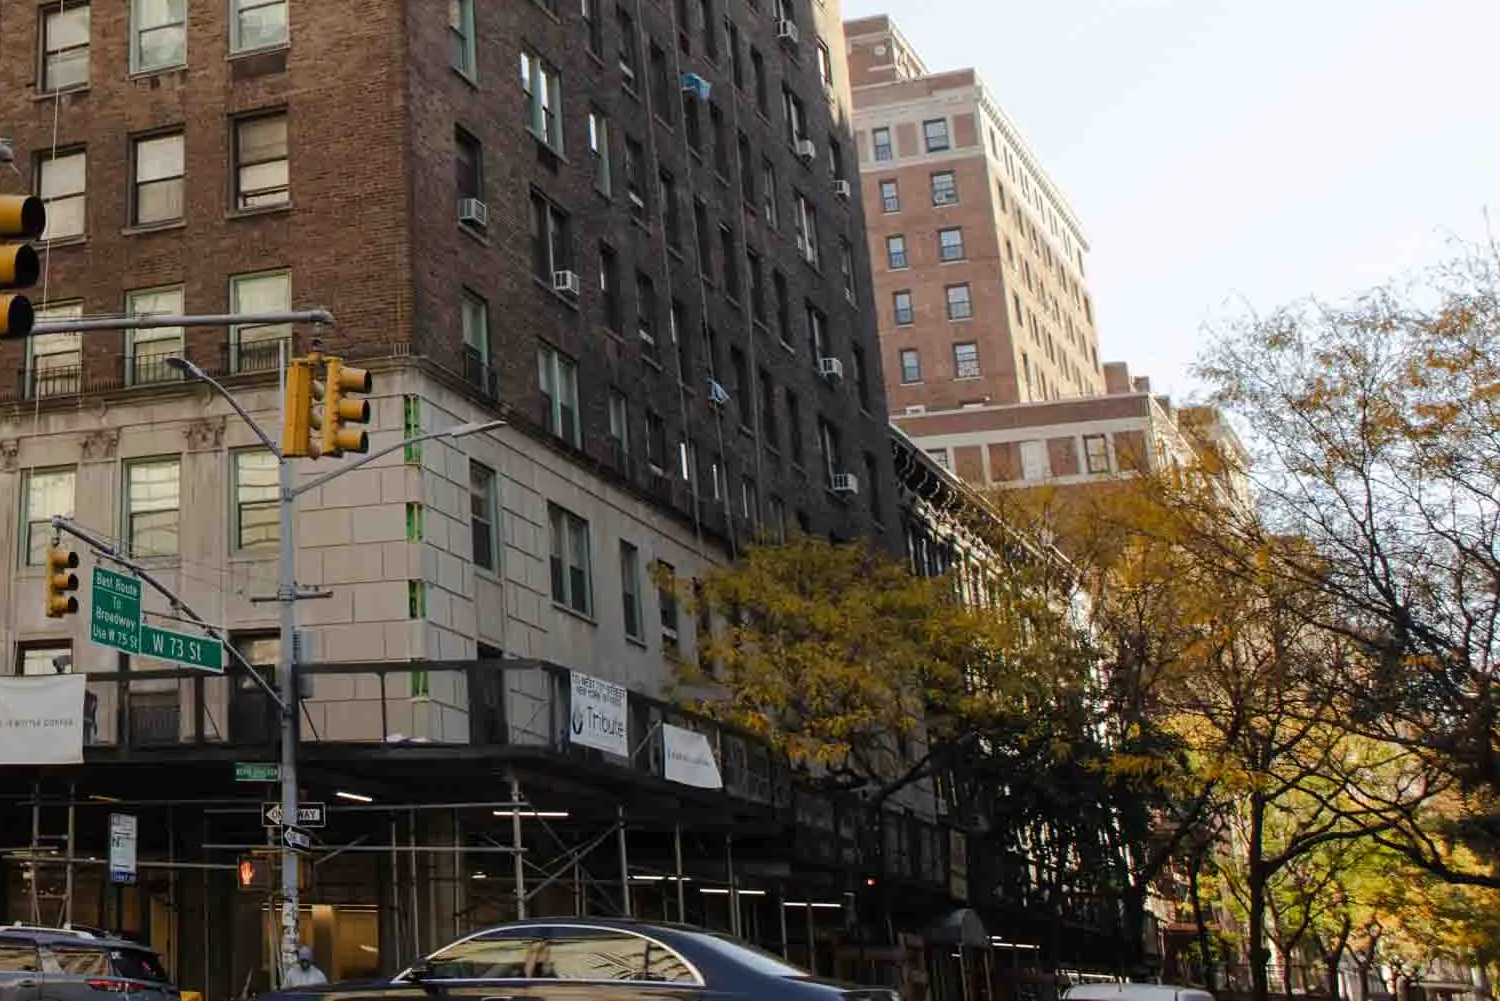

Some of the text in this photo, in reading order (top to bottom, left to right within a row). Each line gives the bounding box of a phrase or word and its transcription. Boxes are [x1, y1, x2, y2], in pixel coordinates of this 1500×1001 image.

[96, 571, 138, 596] Best Route
[113, 596, 122, 609] To
[96, 607, 135, 630] Broadway
[92, 623, 138, 649] Use W 75 St
[152, 633, 202, 661] W 73 St
[587, 705, 625, 738] Tribute
